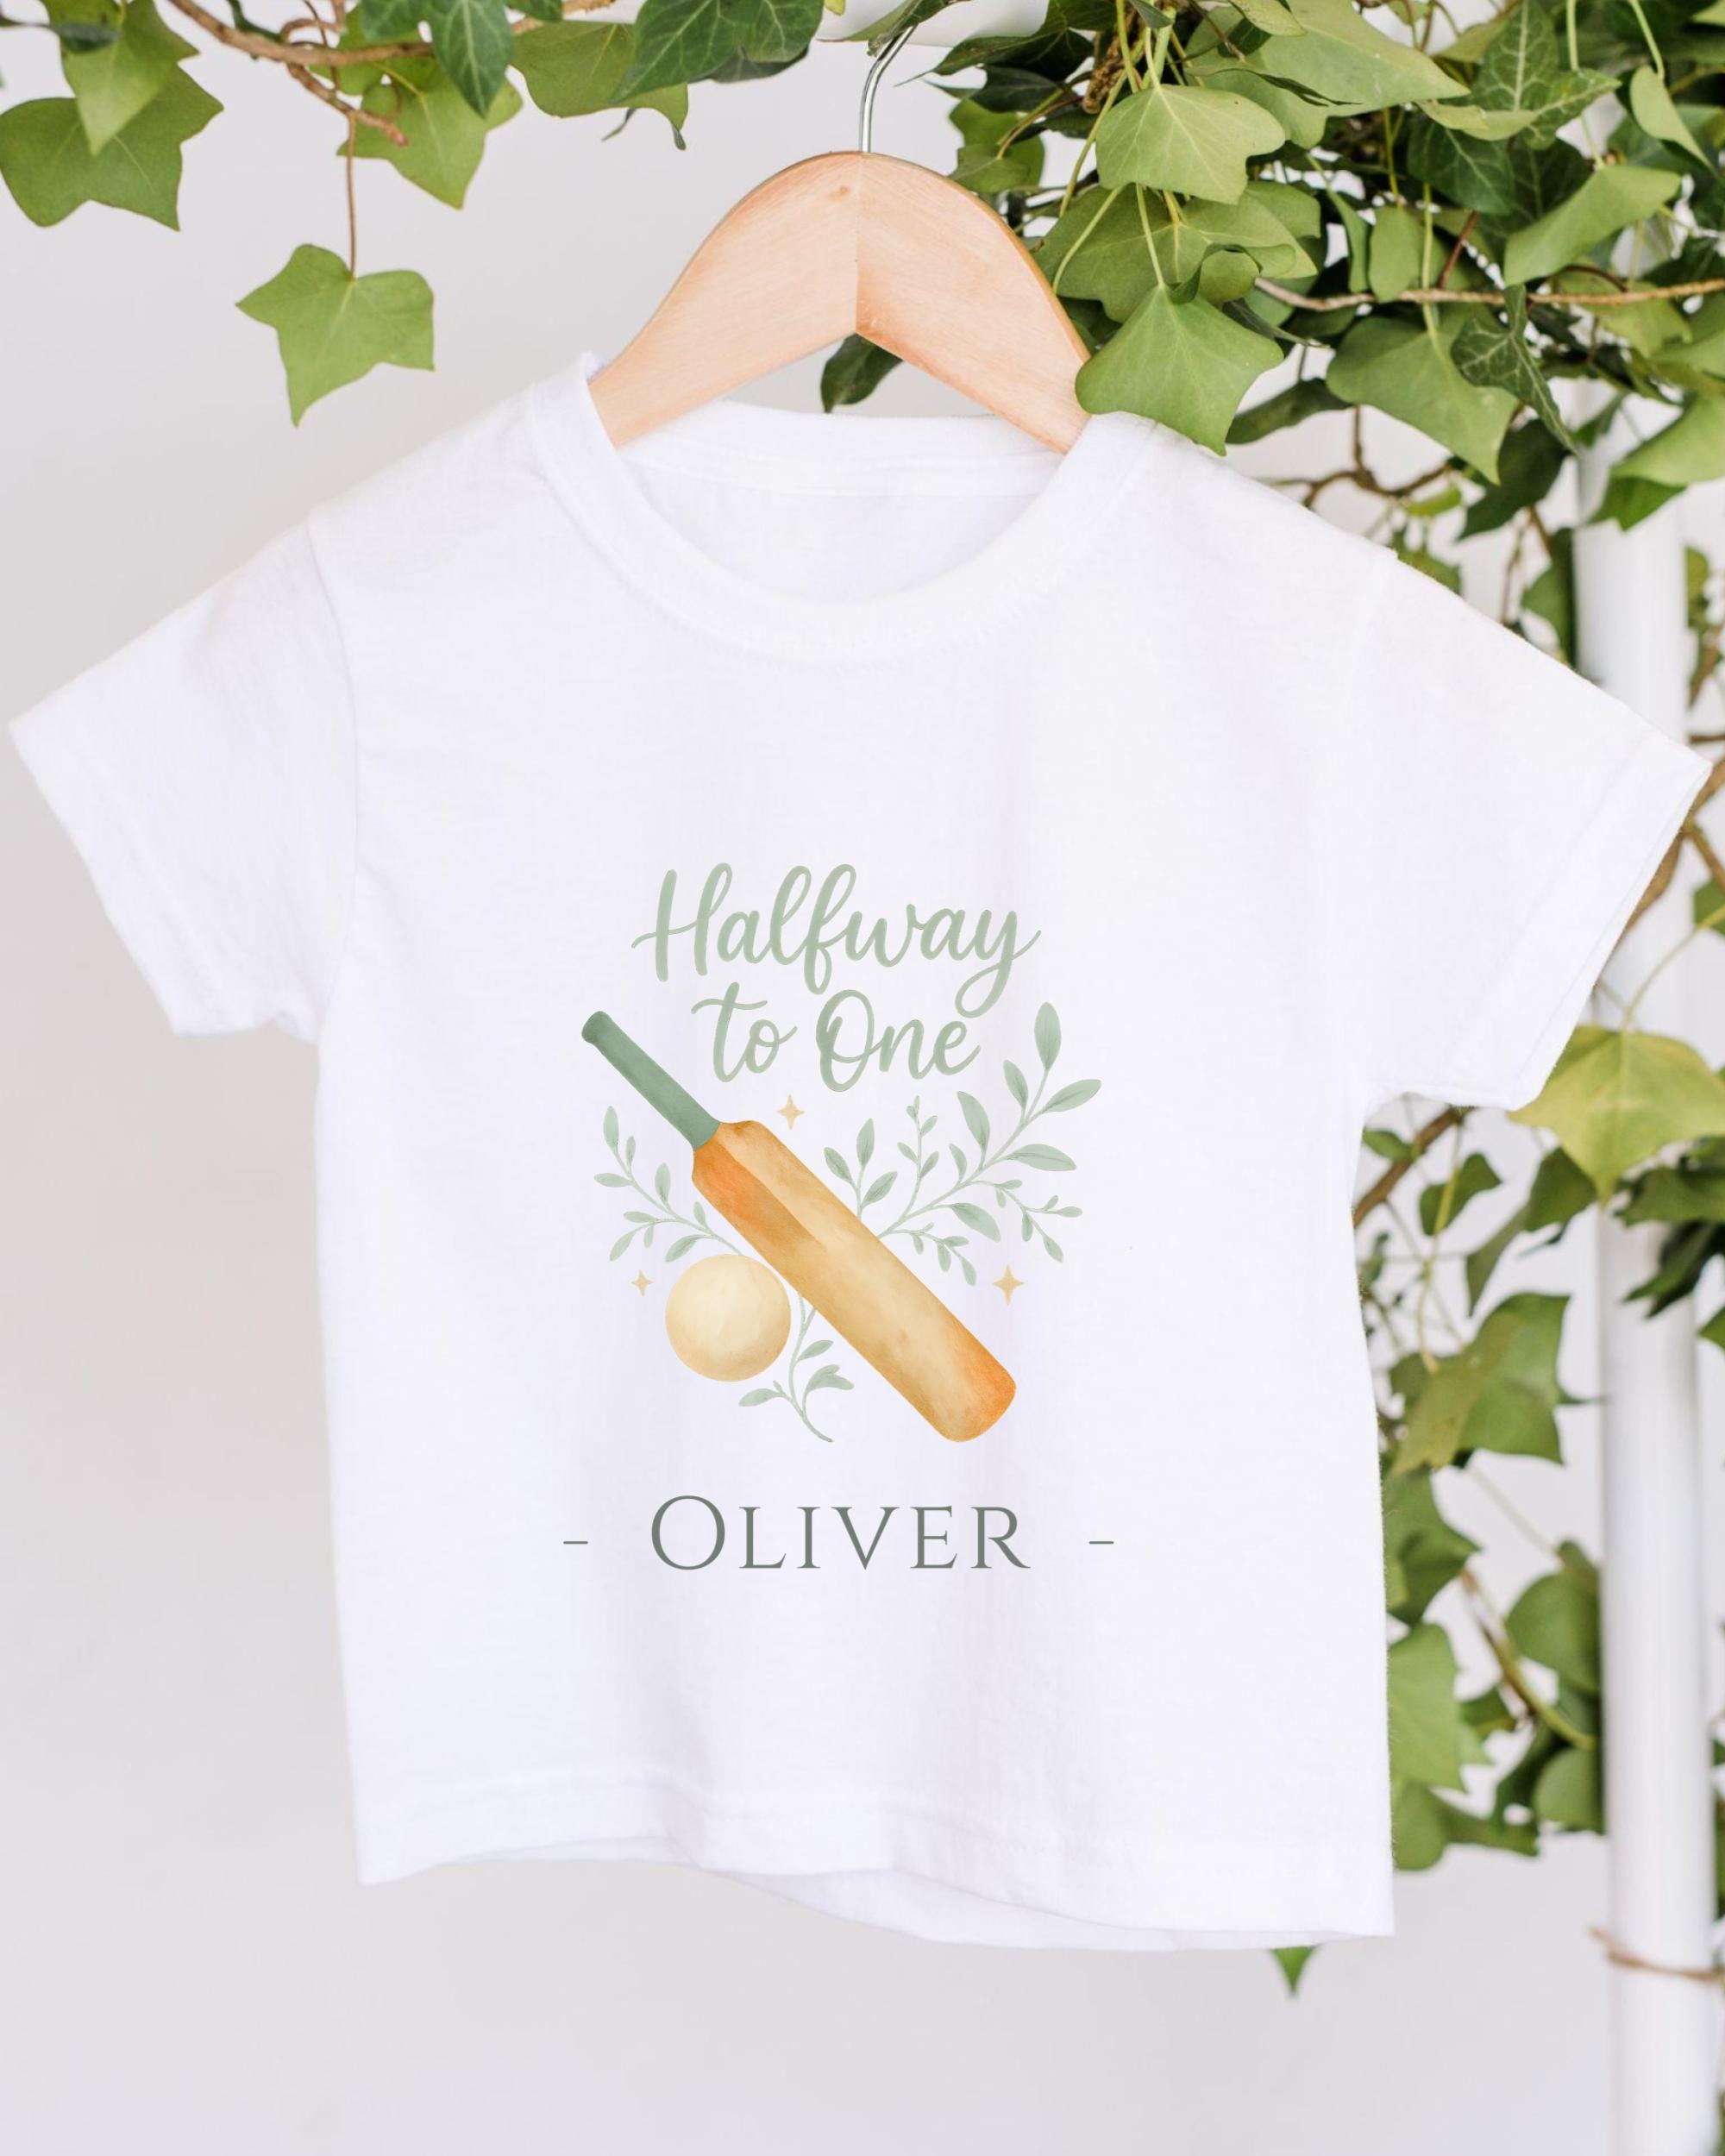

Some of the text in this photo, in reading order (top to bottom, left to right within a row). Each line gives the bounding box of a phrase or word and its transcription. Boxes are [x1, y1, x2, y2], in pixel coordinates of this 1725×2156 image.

[630, 862, 1042, 1019] Halfway
[690, 981, 982, 1093] to One
[650, 1495, 1032, 1571] OLIVER
